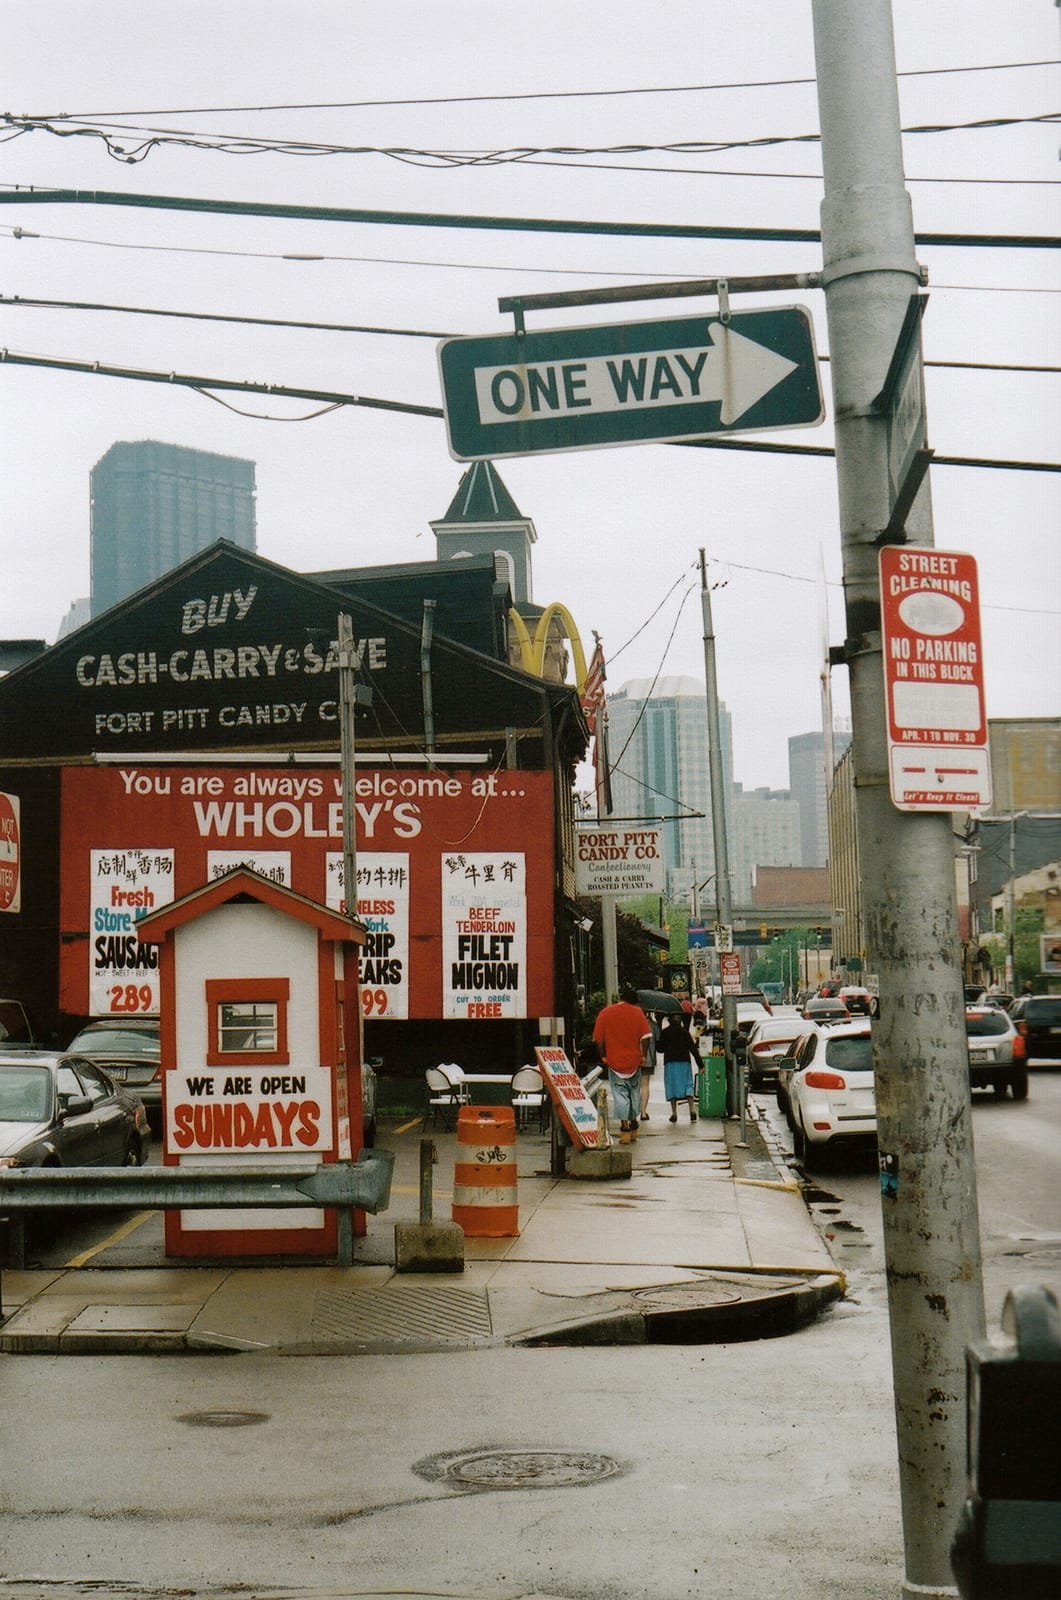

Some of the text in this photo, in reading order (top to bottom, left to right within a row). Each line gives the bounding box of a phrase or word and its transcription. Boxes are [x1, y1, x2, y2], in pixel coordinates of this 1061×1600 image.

[491, 352, 709, 416] ONE WAY
[900, 553, 958, 575] STREET
[890, 574, 972, 603] CLEANING
[181, 585, 258, 635] BUY
[891, 637, 977, 664] NO PARKING
[896, 662, 974, 681] IN THIS BLOCK
[95, 700, 367, 734] FORT PITT CANDY C.
[902, 730, 976, 743] APR. 1 TO NOV. 30
[119, 771, 171, 795] You
[181, 776, 224, 796] are
[234, 773, 323, 800] always
[904, 792, 924, 801] Let's
[926, 792, 944, 802] Keep
[193, 799, 422, 838] WHOLEY'S
[578, 832, 658, 847] FORT PITT
[578, 846, 660, 861] CANDY CO.
[588, 861, 651, 873] Confectionery
[622, 882, 653, 890] PEANUTS
[111, 886, 154, 907] Fresh
[340, 900, 395, 915] BNELESS
[469, 907, 501, 920] BEEF
[95, 908, 131, 931] Store
[365, 917, 389, 932] York
[456, 920, 516, 933] TENDERLOIN
[95, 936, 160, 969] SAUSAG
[458, 935, 514, 961] FILET
[452, 963, 519, 990] MIGNON
[456, 993, 511, 1003] CUT TO ORDER
[468, 1002, 502, 1018] FREE
[186, 1076, 305, 1096] WE ARE OPEN
[173, 1100, 321, 1149] SUNDAYS
